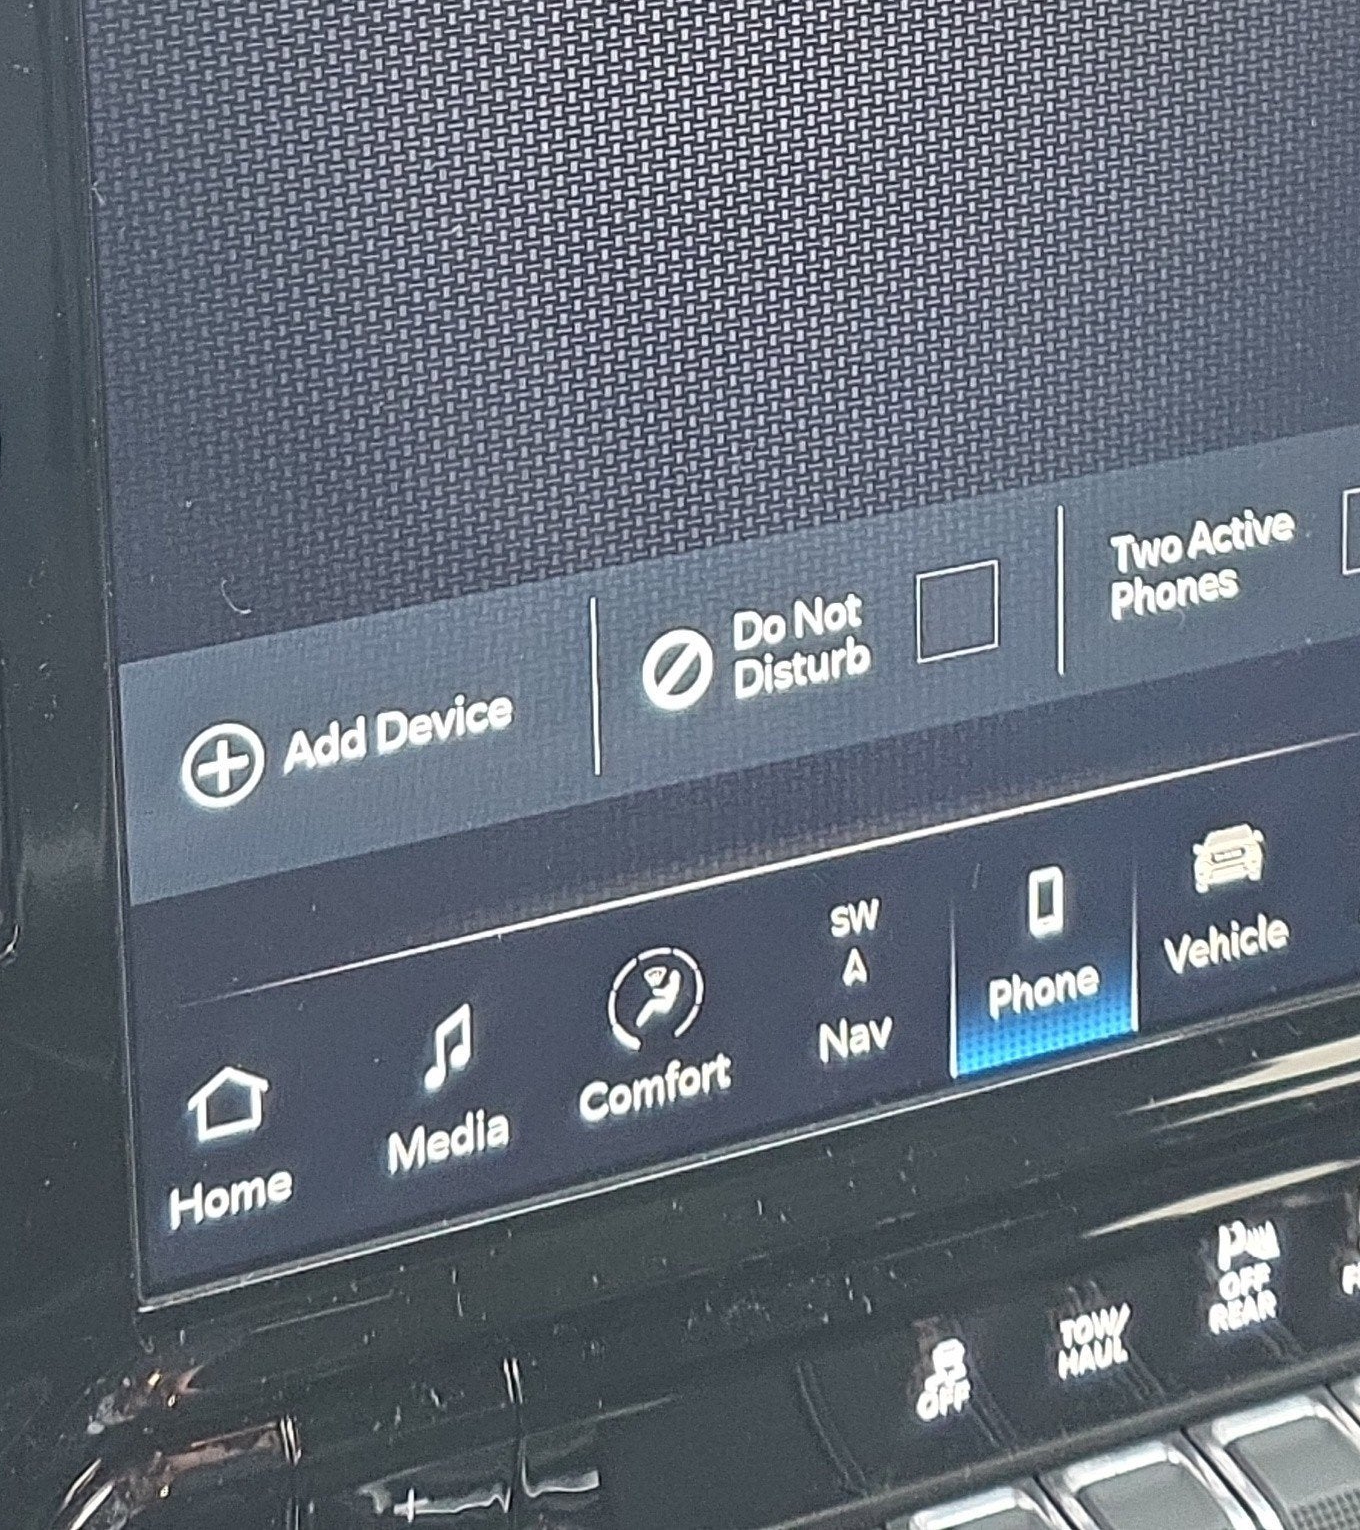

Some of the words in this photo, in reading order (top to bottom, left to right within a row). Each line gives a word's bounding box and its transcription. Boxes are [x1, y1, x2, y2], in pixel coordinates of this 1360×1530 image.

[1110, 533, 1180, 573] Two
[1188, 508, 1296, 553] Active
[733, 608, 787, 651] Do
[794, 592, 863, 638] Not
[1111, 568, 1240, 620] Phones
[734, 636, 872, 700] Disturb
[283, 721, 367, 774] Add
[376, 693, 515, 756] Device
[830, 898, 880, 938] SW
[1163, 913, 1290, 974] Vehicle
[988, 963, 1101, 1020] Phone
[818, 1016, 893, 1064] Nav
[578, 1052, 732, 1123] Comfort
[388, 1111, 509, 1174] Media
[169, 1170, 293, 1230] Home
[1218, 1262, 1272, 1301] OFF
[1059, 1302, 1132, 1350] TOW/
[1208, 1290, 1278, 1335] REAR
[1057, 1335, 1129, 1381] HAUL
[916, 1379, 971, 1422] OFF
